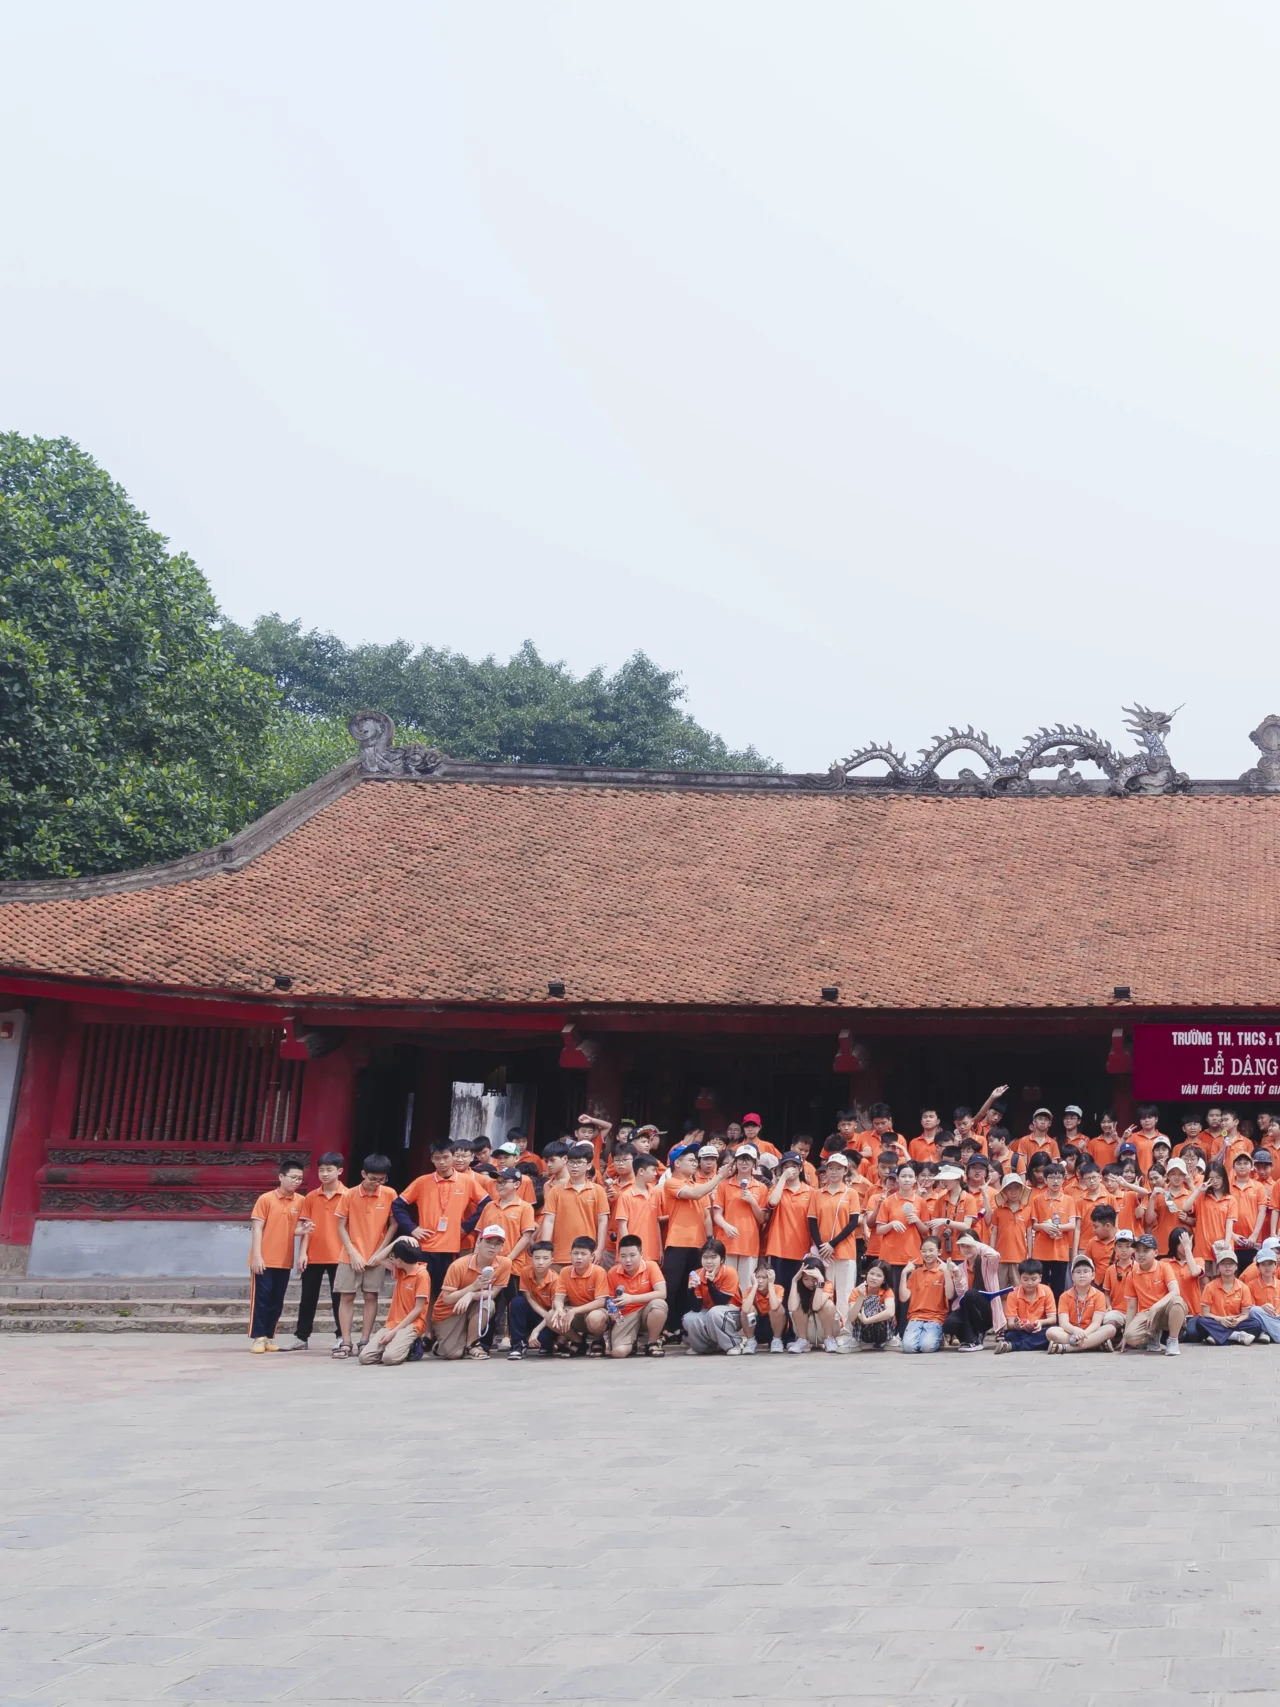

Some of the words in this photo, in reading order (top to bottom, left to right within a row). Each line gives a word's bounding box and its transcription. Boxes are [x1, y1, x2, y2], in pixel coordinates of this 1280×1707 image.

[1171, 1028, 1213, 1046] TRƯỜNG
[1217, 1032, 1235, 1047] TH,
[1237, 1032, 1266, 1046] THCS
[1203, 1050, 1225, 1076] LỄ
[1230, 1054, 1279, 1076] DÂNG
[1201, 1081, 1224, 1095] MIẾU
